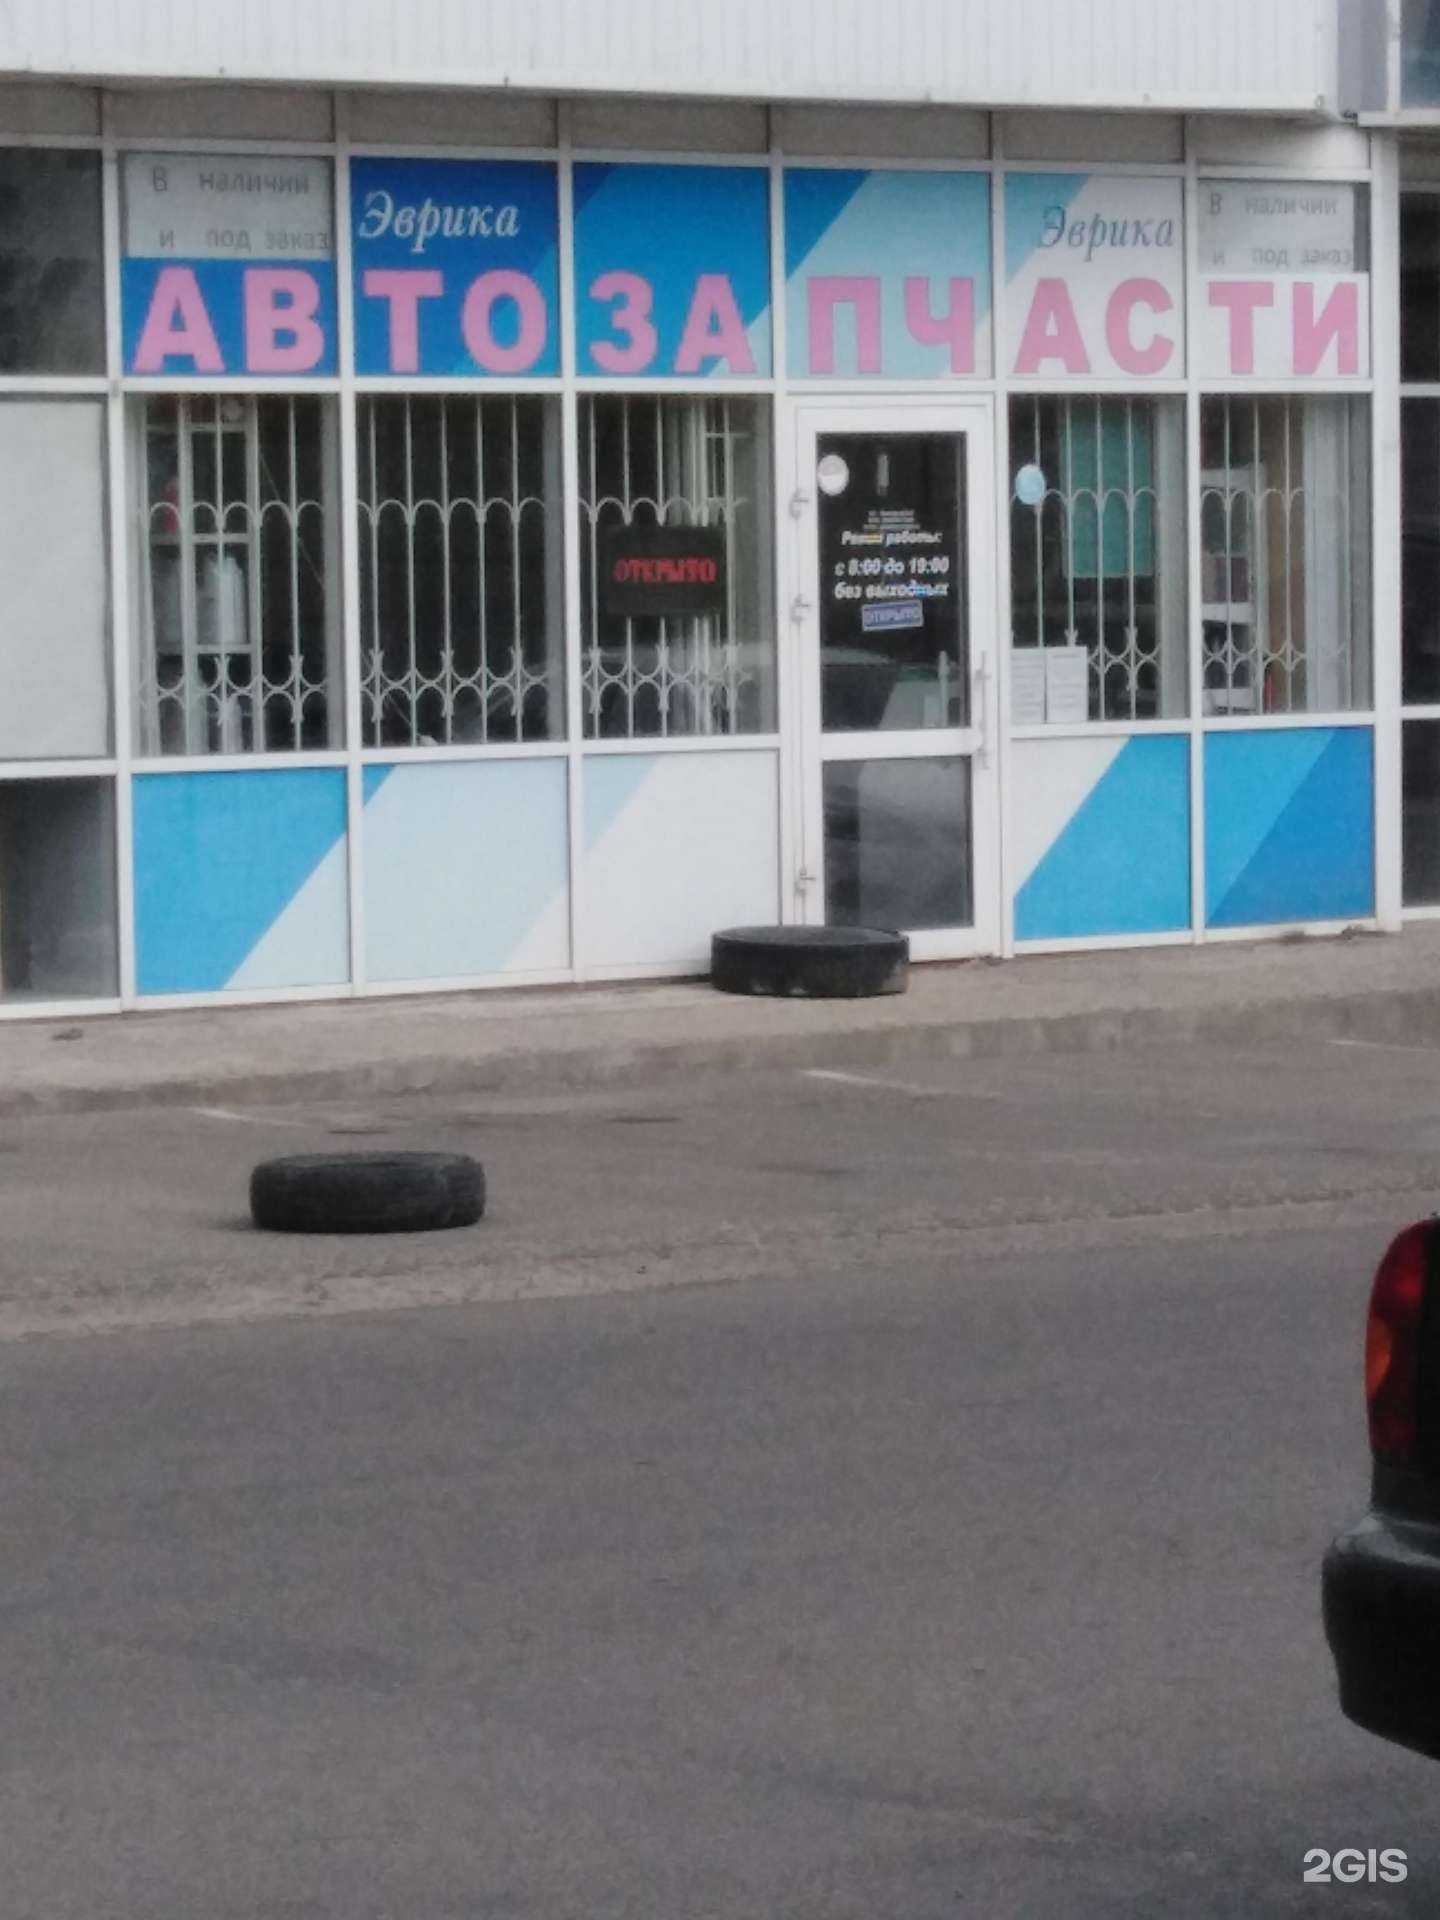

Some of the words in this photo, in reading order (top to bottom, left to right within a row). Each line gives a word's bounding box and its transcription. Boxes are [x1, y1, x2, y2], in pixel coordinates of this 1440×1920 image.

[200, 171, 310, 195] наличии
[359, 190, 520, 253] Эврика
[1038, 206, 1175, 262] Эврика
